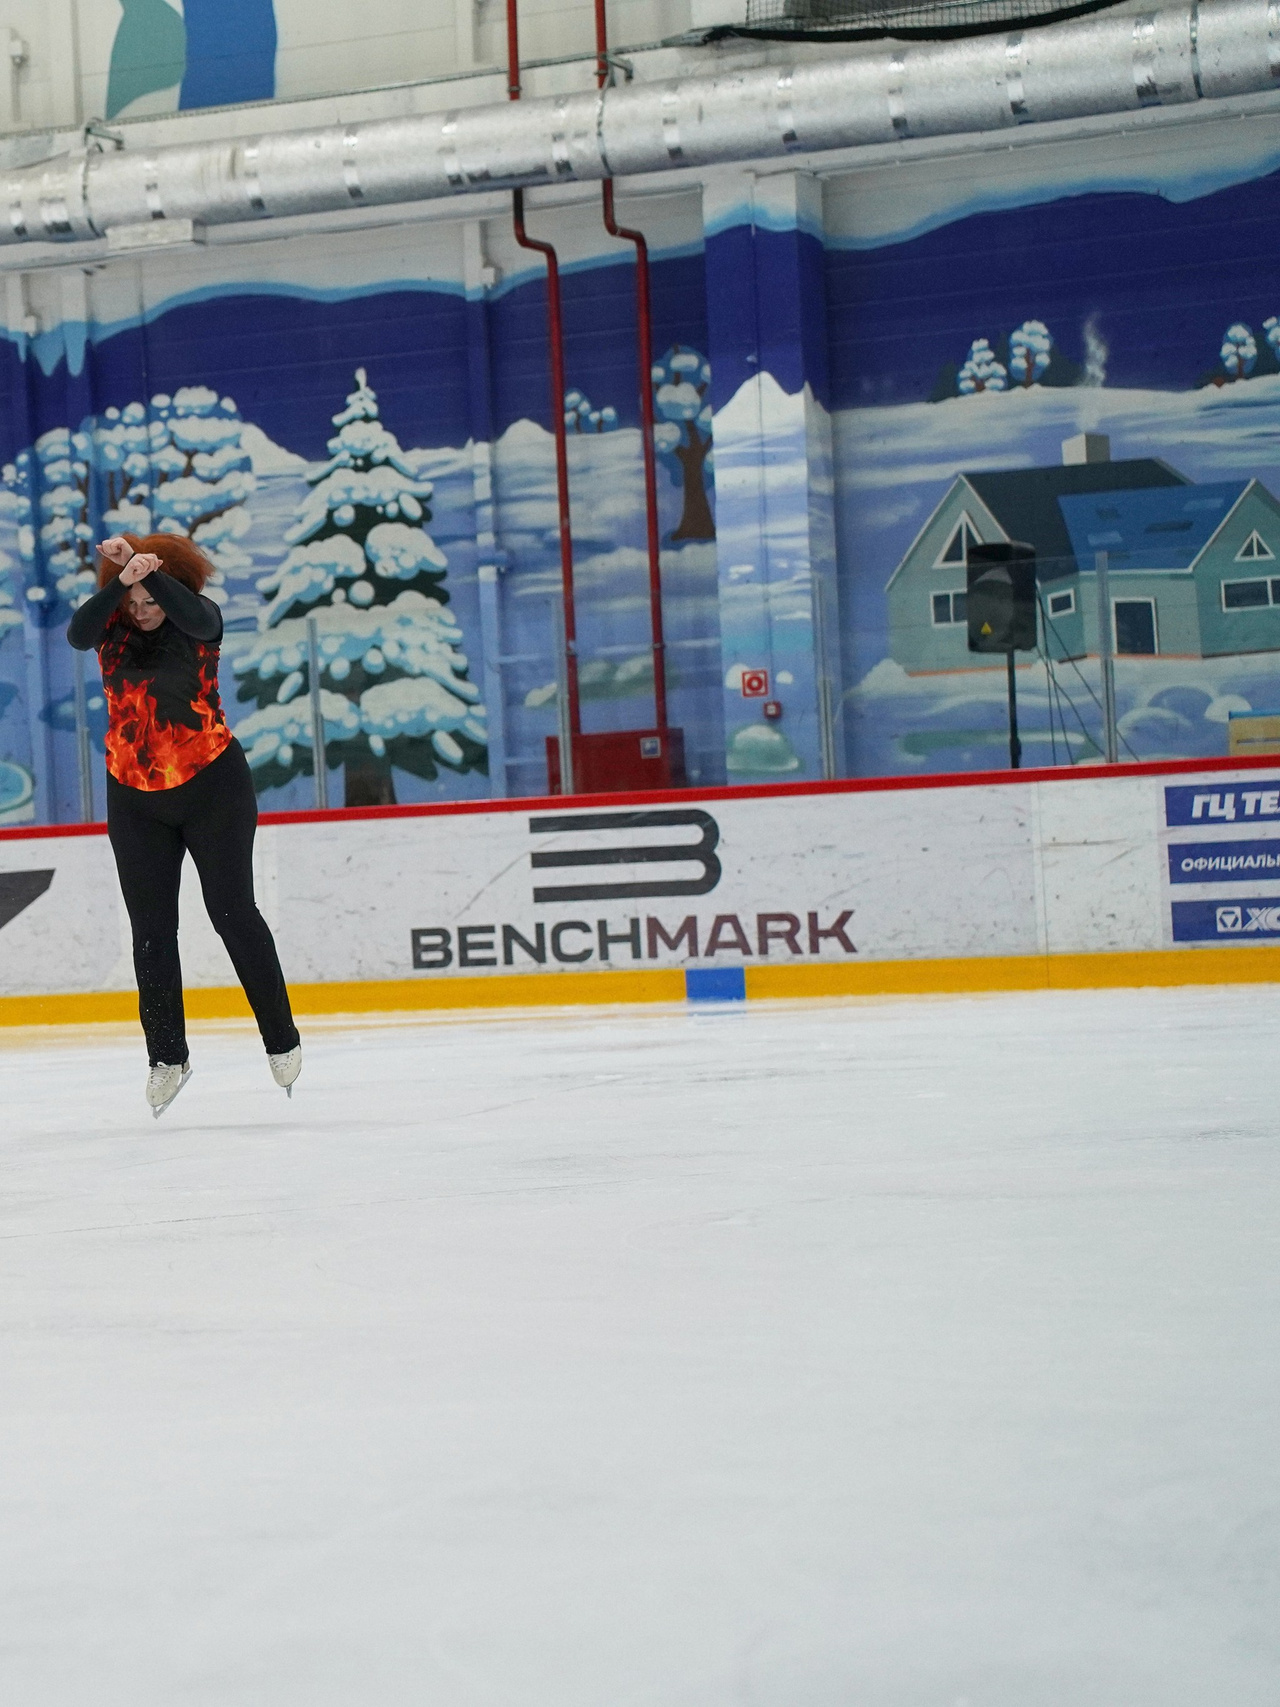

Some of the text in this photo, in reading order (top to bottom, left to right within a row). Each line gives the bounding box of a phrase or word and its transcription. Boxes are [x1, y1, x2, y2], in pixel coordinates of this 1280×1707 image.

[1192, 793, 1236, 820] ГЦ
[1181, 854, 1280, 872] ОФИЦИАЛЬ
[411, 910, 859, 970] BENCHMARK
